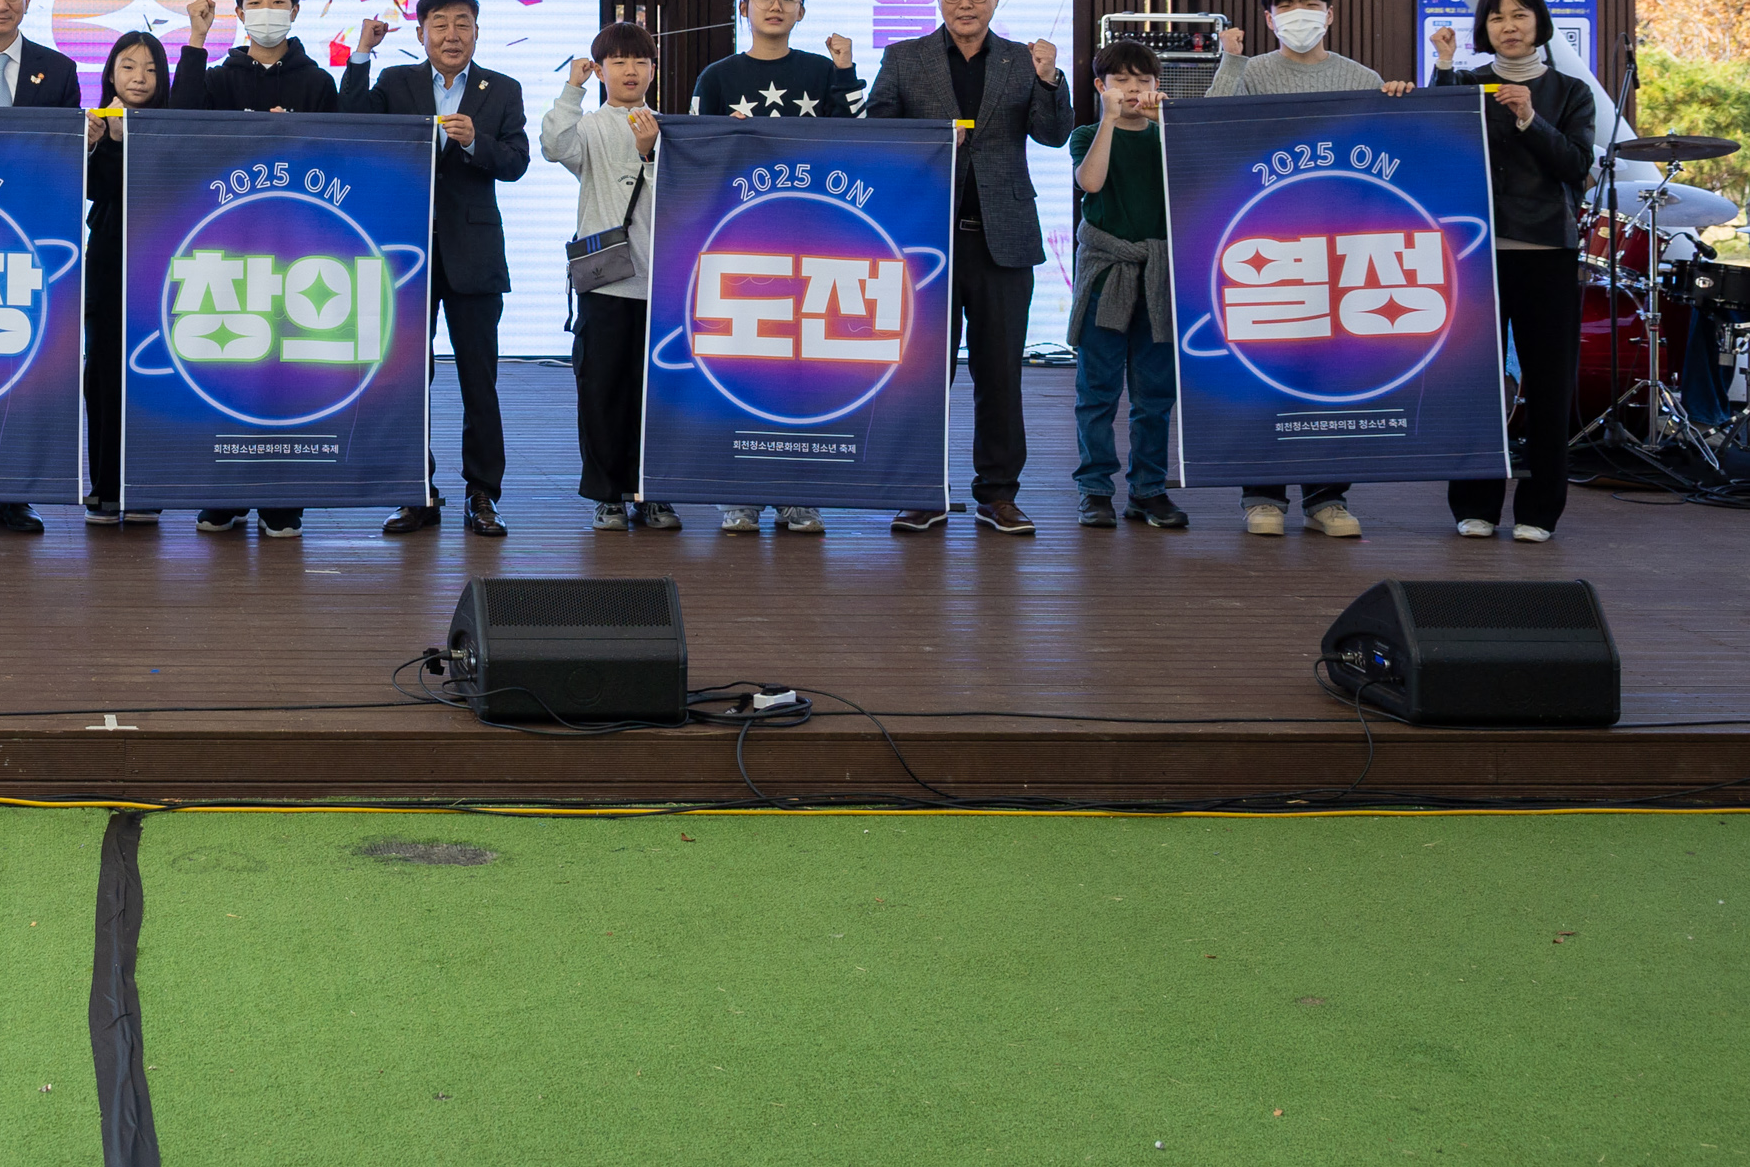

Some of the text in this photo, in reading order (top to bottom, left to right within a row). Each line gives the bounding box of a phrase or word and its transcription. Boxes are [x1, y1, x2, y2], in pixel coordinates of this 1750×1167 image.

[209, 162, 352, 207] 2025 ON
[732, 163, 875, 210] 2025 ON
[1251, 141, 1401, 187] 2025 ON
[170, 249, 386, 363] 창의
[692, 251, 906, 365] 도전
[1220, 231, 1449, 343] 열정
[732, 440, 857, 454] 회천청소년문화의집 청소년 축제
[1274, 417, 1408, 432] 회천청소년문화의집 청소년 축제
[213, 443, 339, 454] 회천청소년문화의집 청소년 축제
